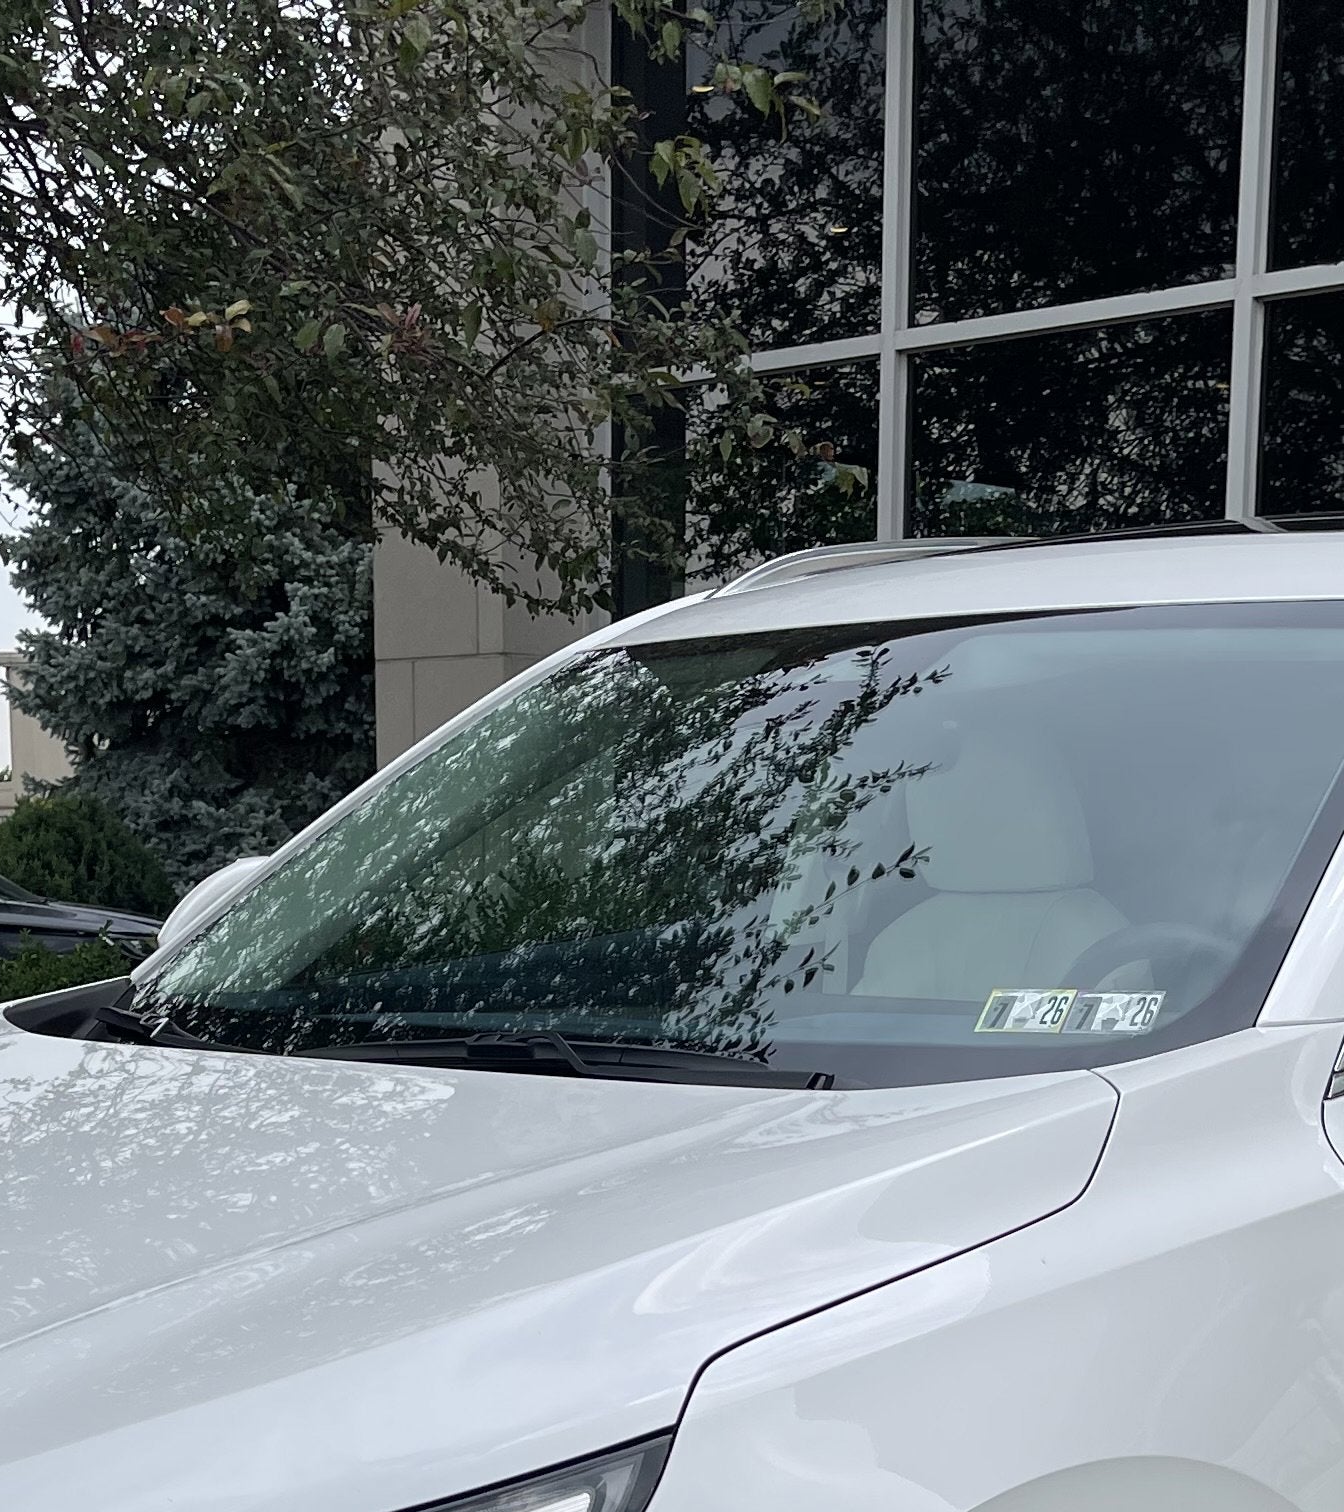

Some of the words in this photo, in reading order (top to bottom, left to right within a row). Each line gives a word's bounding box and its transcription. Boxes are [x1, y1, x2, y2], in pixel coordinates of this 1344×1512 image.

[989, 1002, 1009, 1029] 7
[1039, 996, 1069, 1026] 26
[1075, 1003, 1096, 1030] 7
[1129, 997, 1159, 1027] 26
